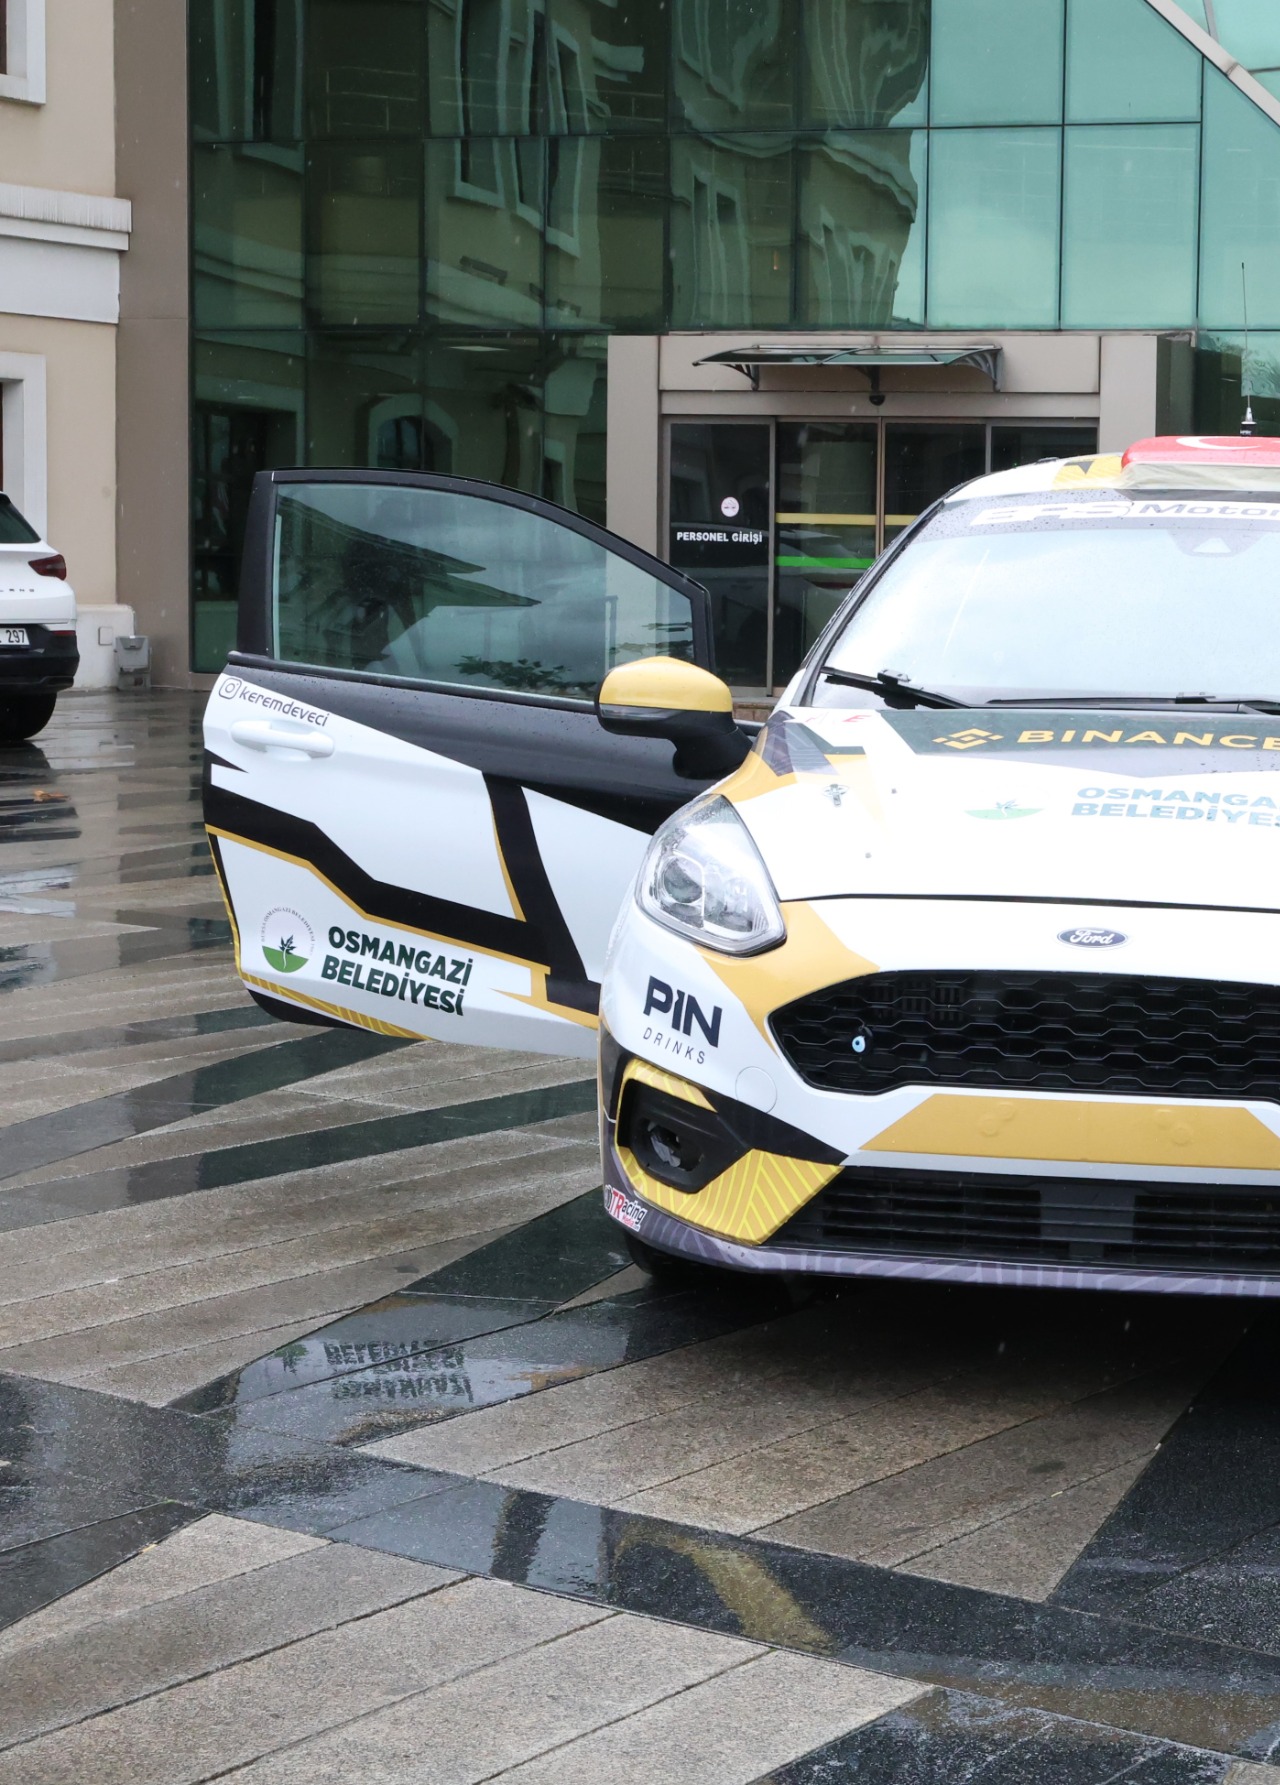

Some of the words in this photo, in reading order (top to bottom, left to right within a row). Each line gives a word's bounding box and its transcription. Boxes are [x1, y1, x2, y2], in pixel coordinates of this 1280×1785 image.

[676, 531, 729, 542] PERSONEL
[731, 531, 763, 545] GİRİŞİ
[5, 629, 25, 643] 297
[239, 686, 330, 727] keremdeveci
[328, 926, 474, 987] OSMANGAZİ
[1069, 929, 1115, 945] Ford
[320, 954, 465, 1017] BELEDİYESİ
[643, 975, 723, 1048] PIN
[643, 1027, 706, 1064] DRINKS
